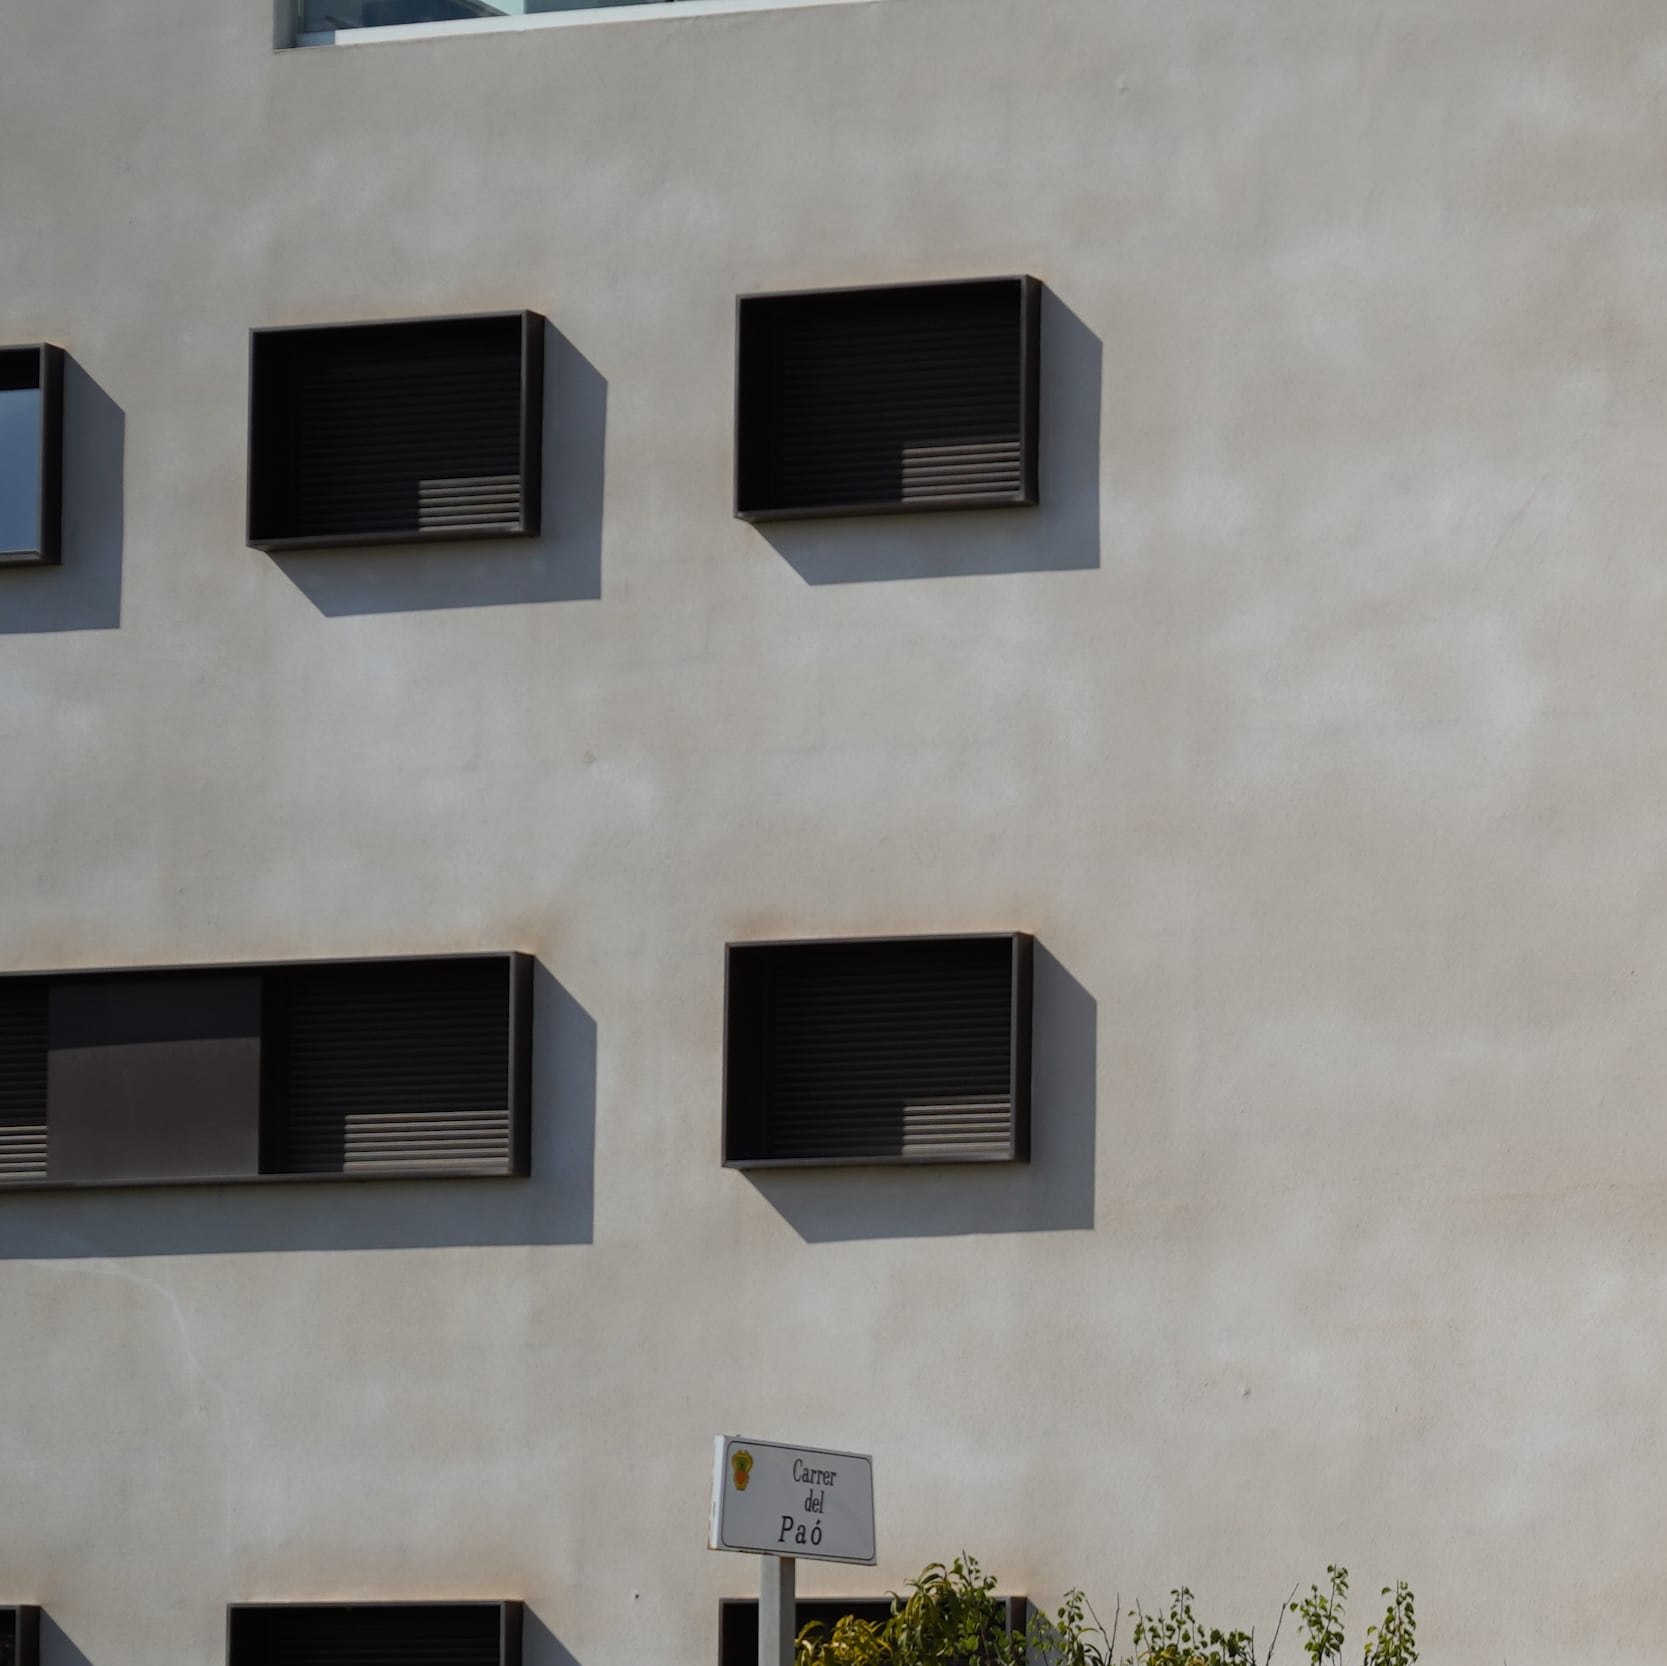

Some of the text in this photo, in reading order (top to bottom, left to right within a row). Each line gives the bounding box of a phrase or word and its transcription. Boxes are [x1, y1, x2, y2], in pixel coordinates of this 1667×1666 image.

[792, 1458, 837, 1487] Carrer
[804, 1488, 825, 1514] del
[778, 1515, 823, 1546] Paó
